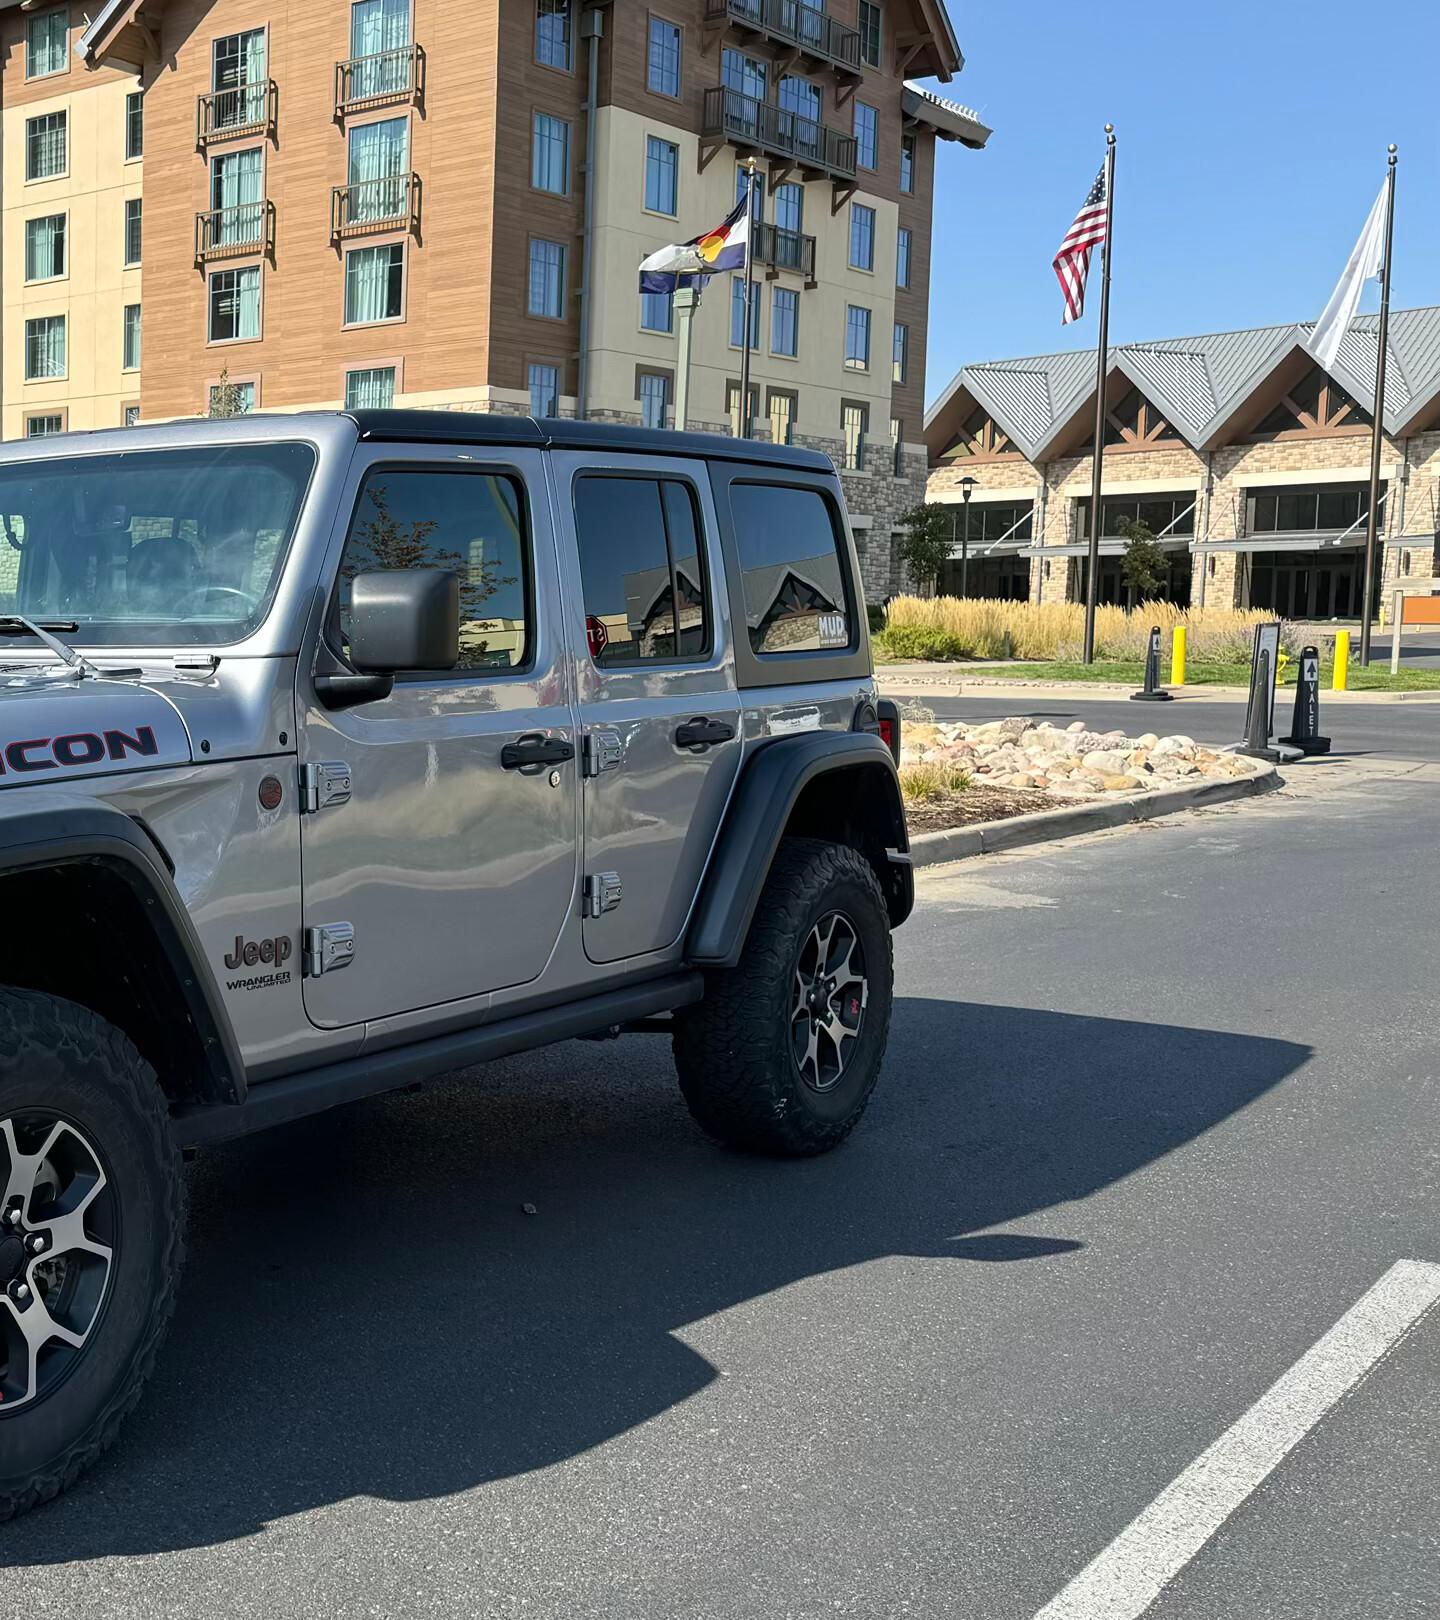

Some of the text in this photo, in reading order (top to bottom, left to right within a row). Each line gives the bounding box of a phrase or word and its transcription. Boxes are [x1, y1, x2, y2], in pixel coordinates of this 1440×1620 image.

[818, 615, 845, 637] MUD
[1308, 682, 1316, 736] VALET
[224, 935, 292, 970] Jeep
[226, 971, 291, 991] WRANGLER
[246, 978, 292, 991] UNLIMITED
